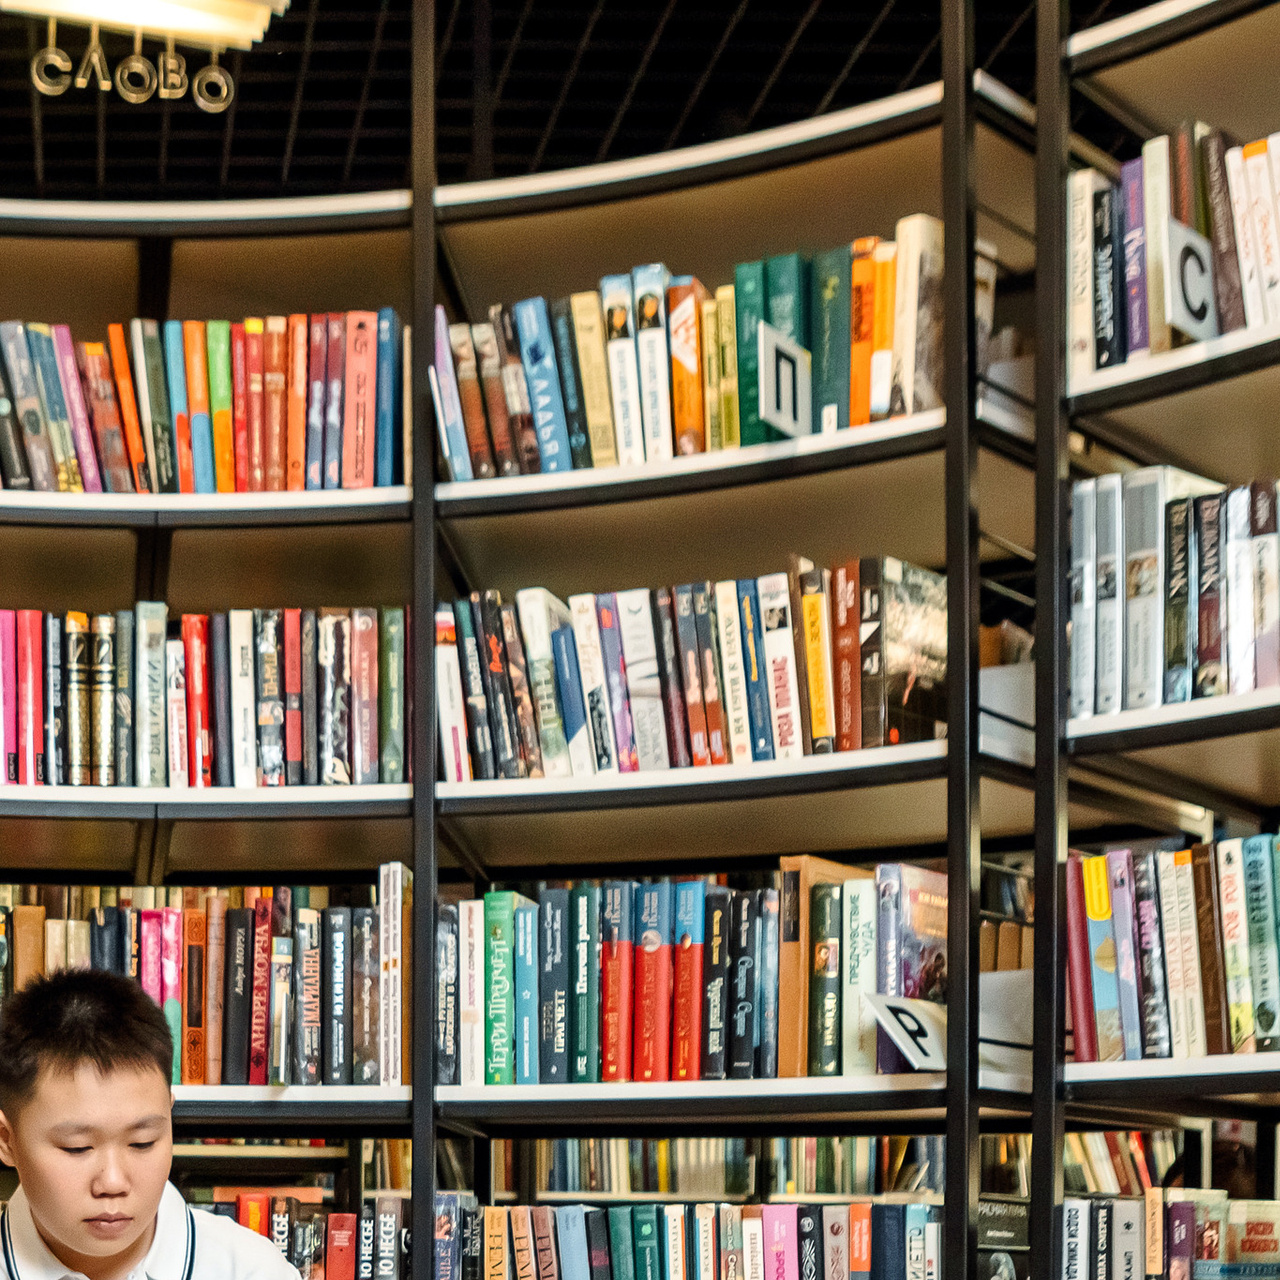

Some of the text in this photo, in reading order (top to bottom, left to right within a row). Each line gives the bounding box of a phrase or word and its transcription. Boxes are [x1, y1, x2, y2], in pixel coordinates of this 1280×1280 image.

[30, 46, 235, 113] СЛОВО
[1180, 245, 1208, 321] С
[774, 346, 799, 423] П
[849, 893, 860, 985] ПРЕДЧУВСТВИЕ
[862, 920, 873, 957] ЧУДА
[252, 923, 269, 1051] АНДРЕ МОРУА
[302, 948, 320, 1023] МАРИАННА
[554, 989, 565, 1053] ПРАТЧЕТТ
[885, 1005, 930, 1057] Р
[671, 1225, 680, 1275] ЭСКАПАДА
[702, 1222, 710, 1273] ЭСКАПАДА
[1098, 1208, 1108, 1251] СМЕРТИ
[360, 1262, 372, 1278] Ю
[379, 1259, 393, 1275] Ю
